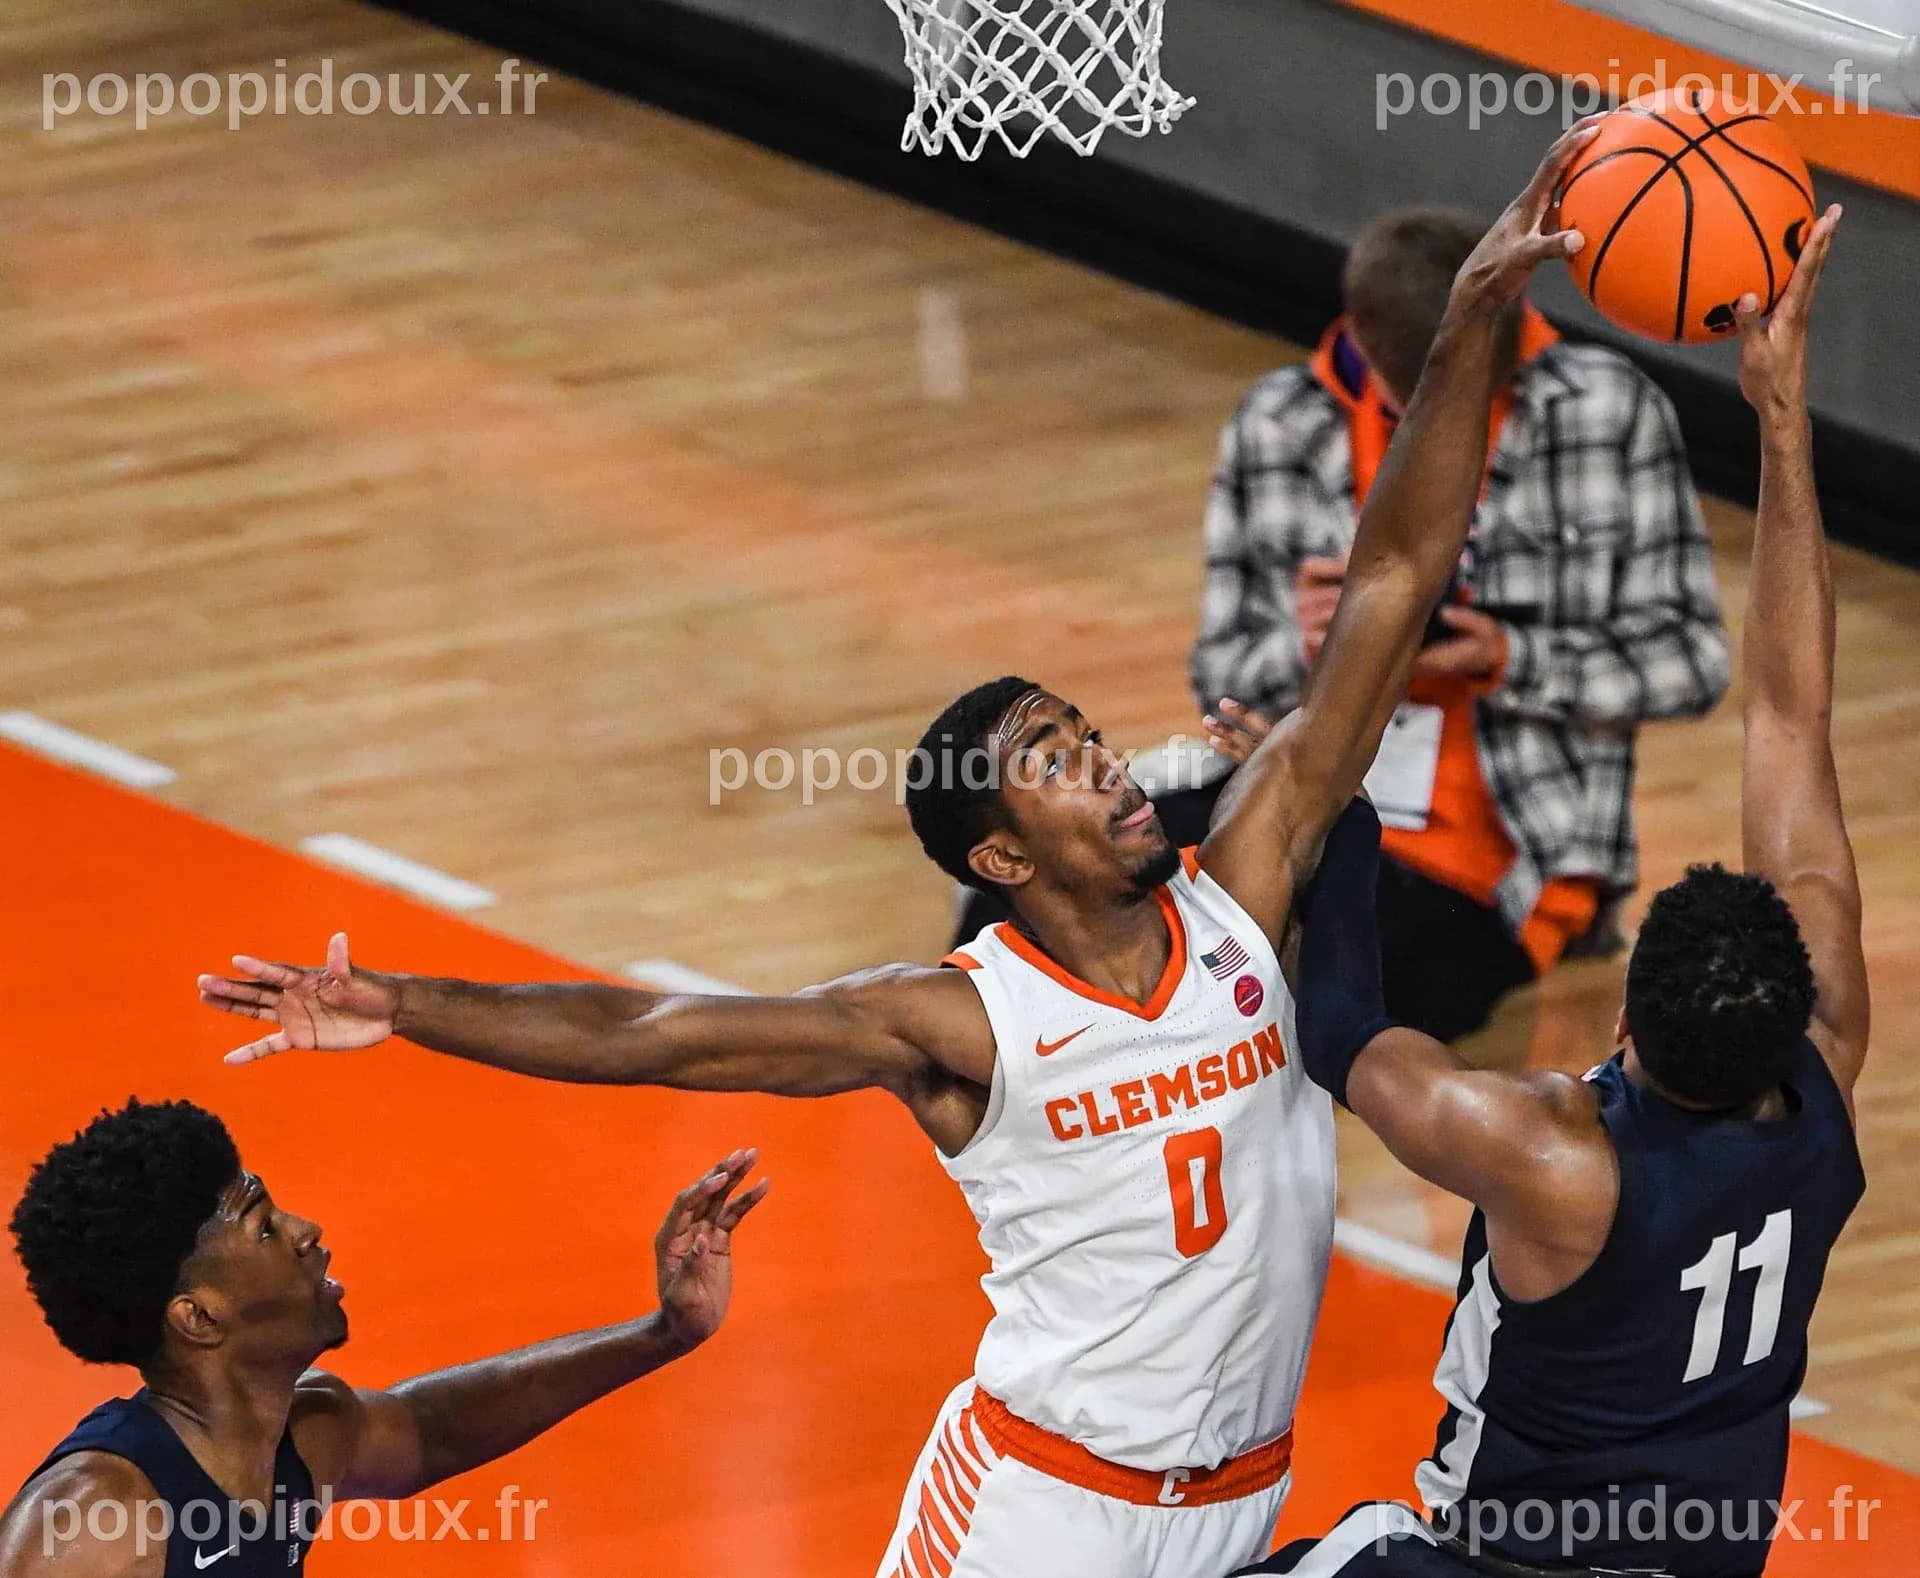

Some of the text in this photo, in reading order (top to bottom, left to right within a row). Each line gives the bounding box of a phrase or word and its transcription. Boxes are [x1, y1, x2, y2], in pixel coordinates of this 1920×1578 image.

[1045, 1022, 1287, 1141] CLEMSON
[1163, 1125, 1228, 1259] 0
[1680, 1208, 1792, 1384] 11
[1157, 1468, 1190, 1505] C
